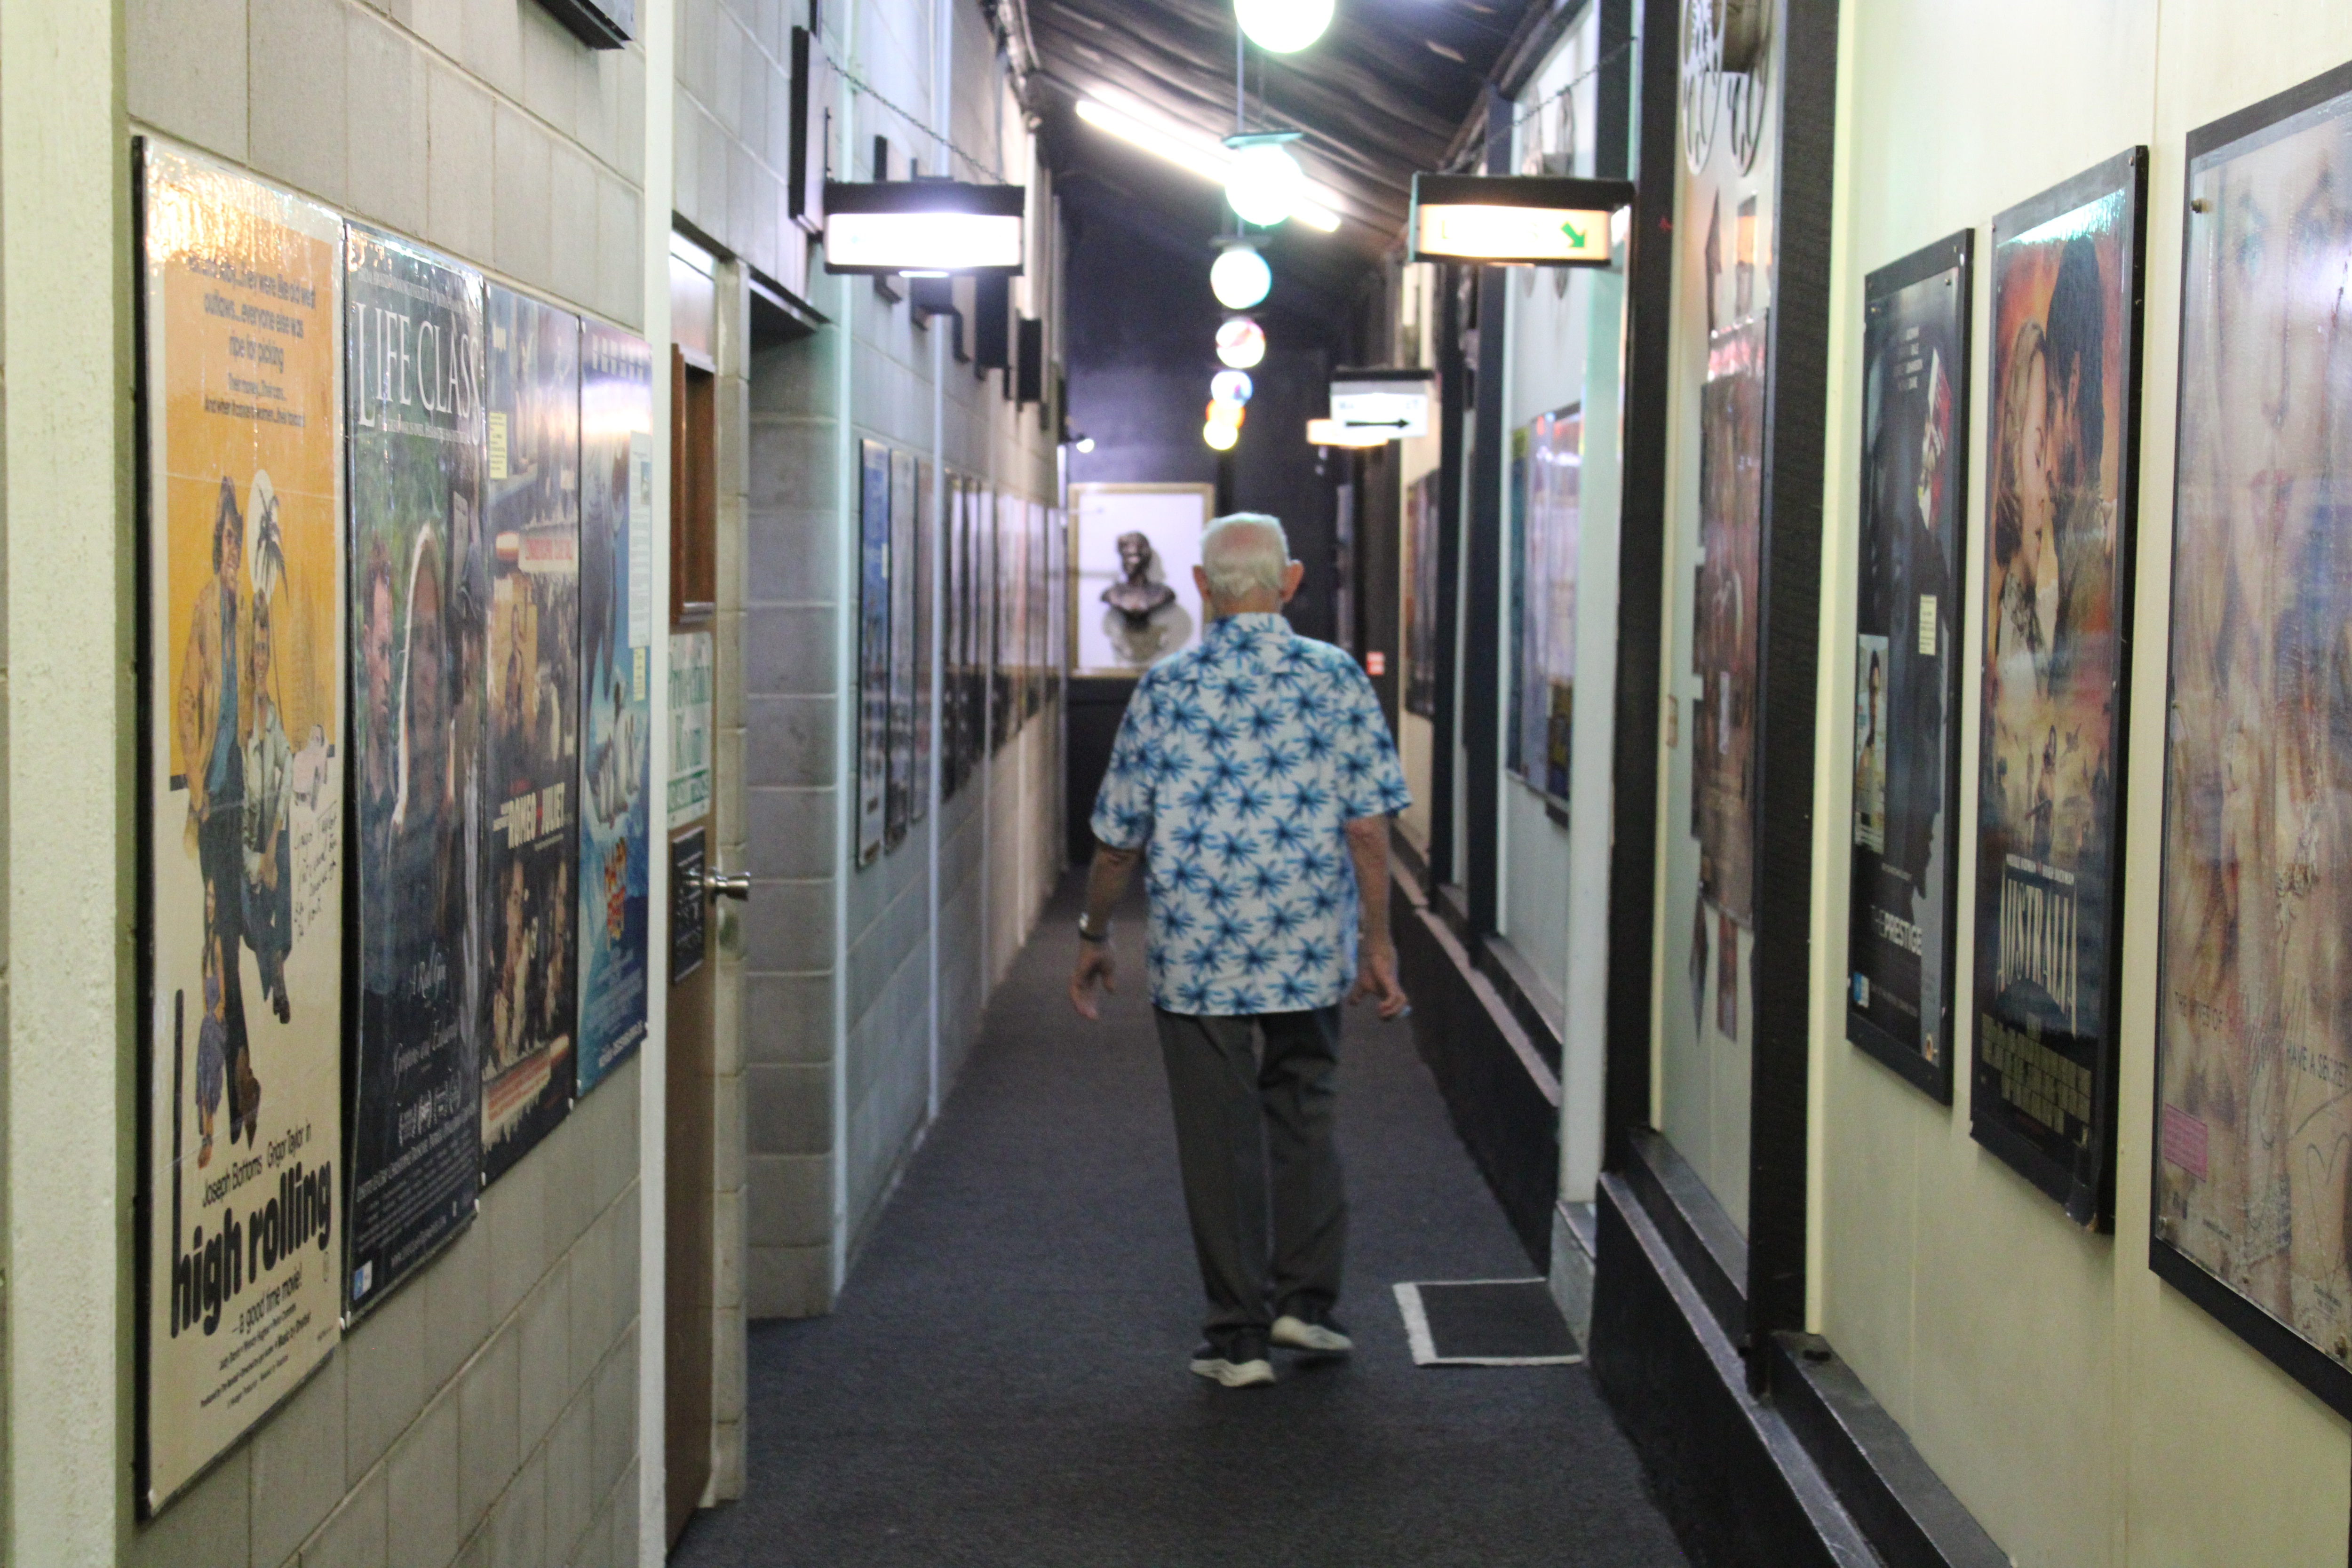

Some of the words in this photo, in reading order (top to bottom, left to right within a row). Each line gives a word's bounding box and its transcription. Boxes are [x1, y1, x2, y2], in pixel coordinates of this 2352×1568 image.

[356, 302, 412, 427] LIFE
[417, 311, 482, 446] CLASS
[1884, 913, 1922, 956] PRESTIGE
[1996, 876, 2077, 1040] AUSTRALIA
[203, 1165, 230, 1208] Joseph
[249, 1161, 331, 1283] rolling
